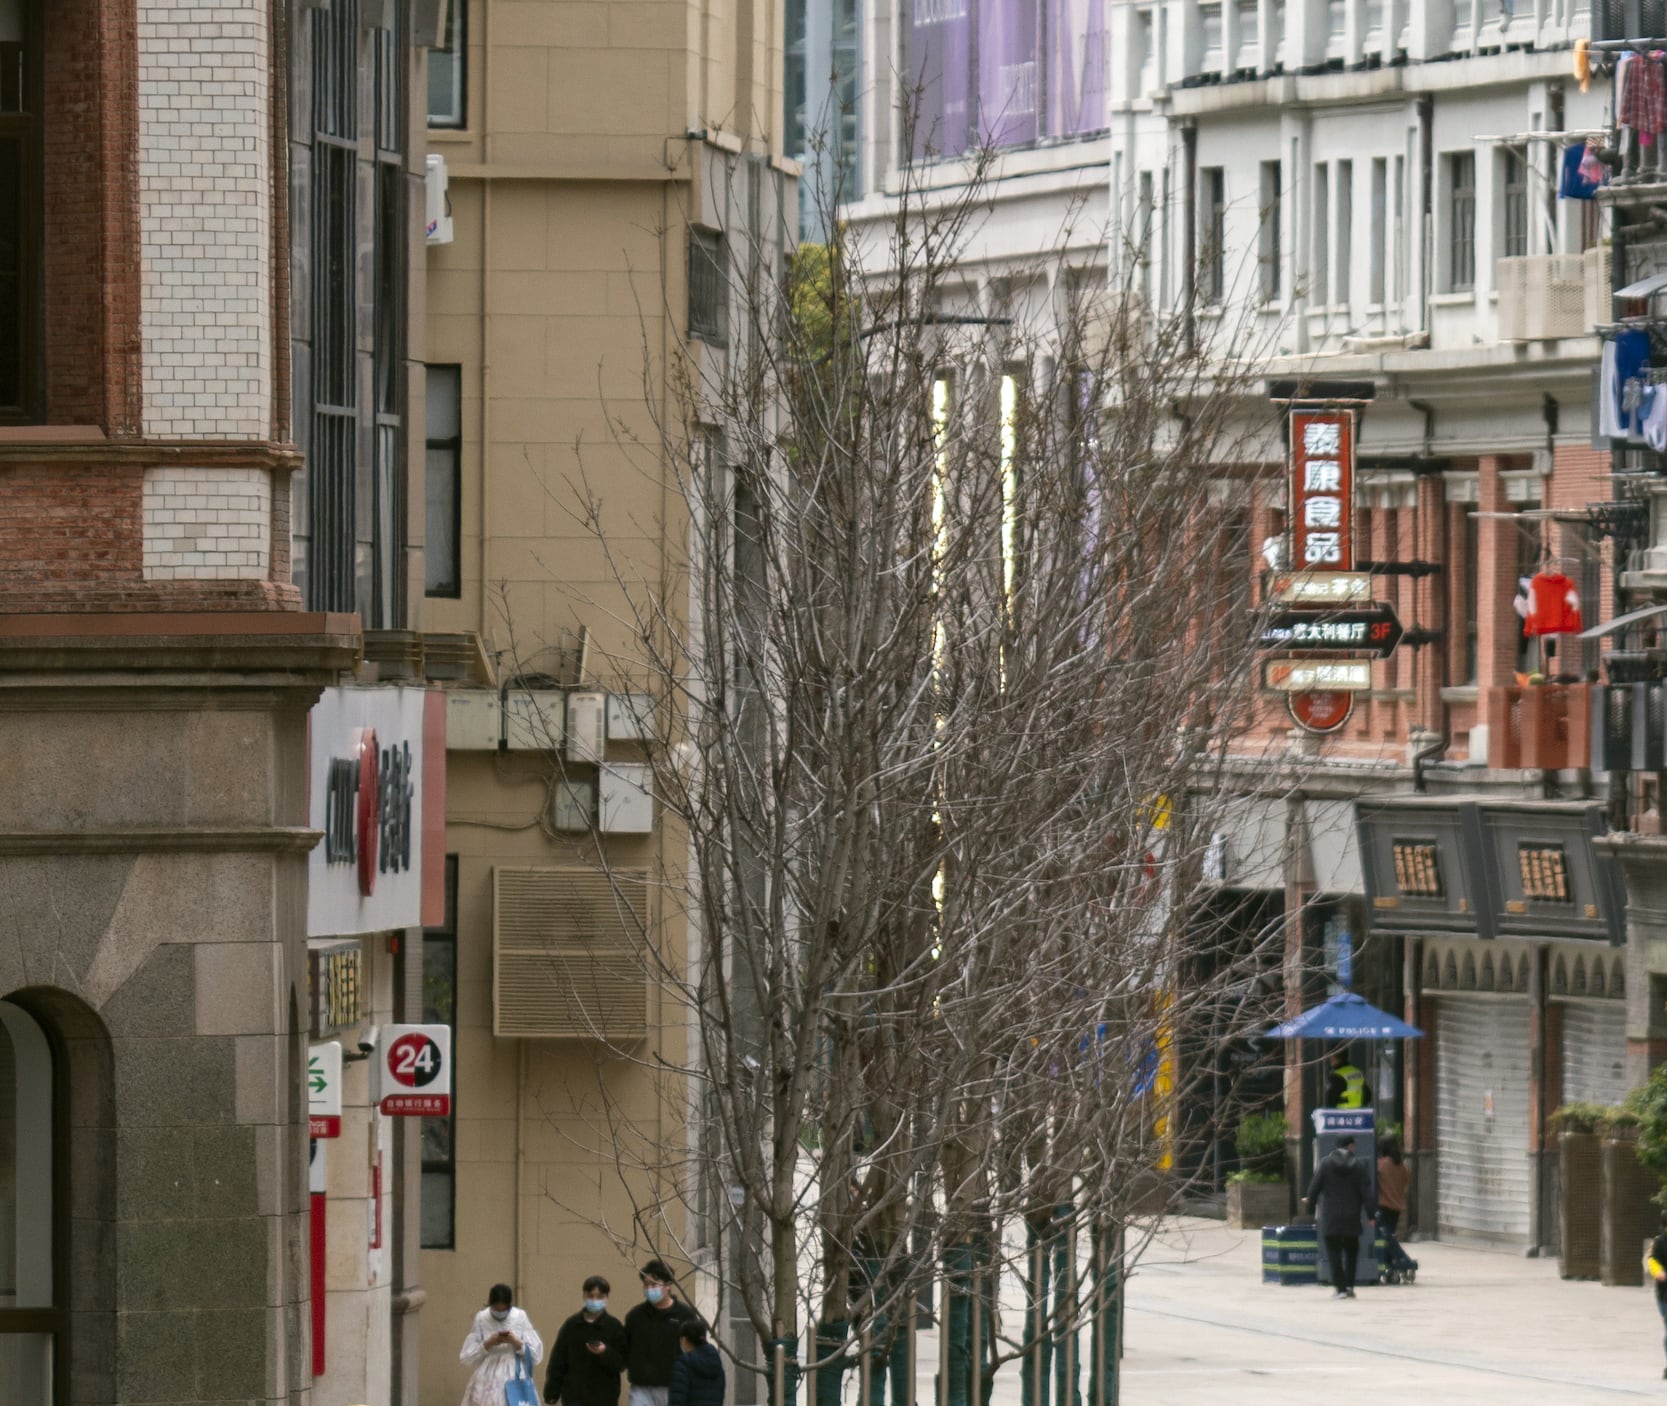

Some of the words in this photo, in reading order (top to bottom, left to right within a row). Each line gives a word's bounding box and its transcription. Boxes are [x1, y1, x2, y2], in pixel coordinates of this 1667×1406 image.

[1303, 422, 1342, 564] 泰康食品
[1371, 622, 1392, 640] 3F
[396, 1044, 434, 1073] 24
